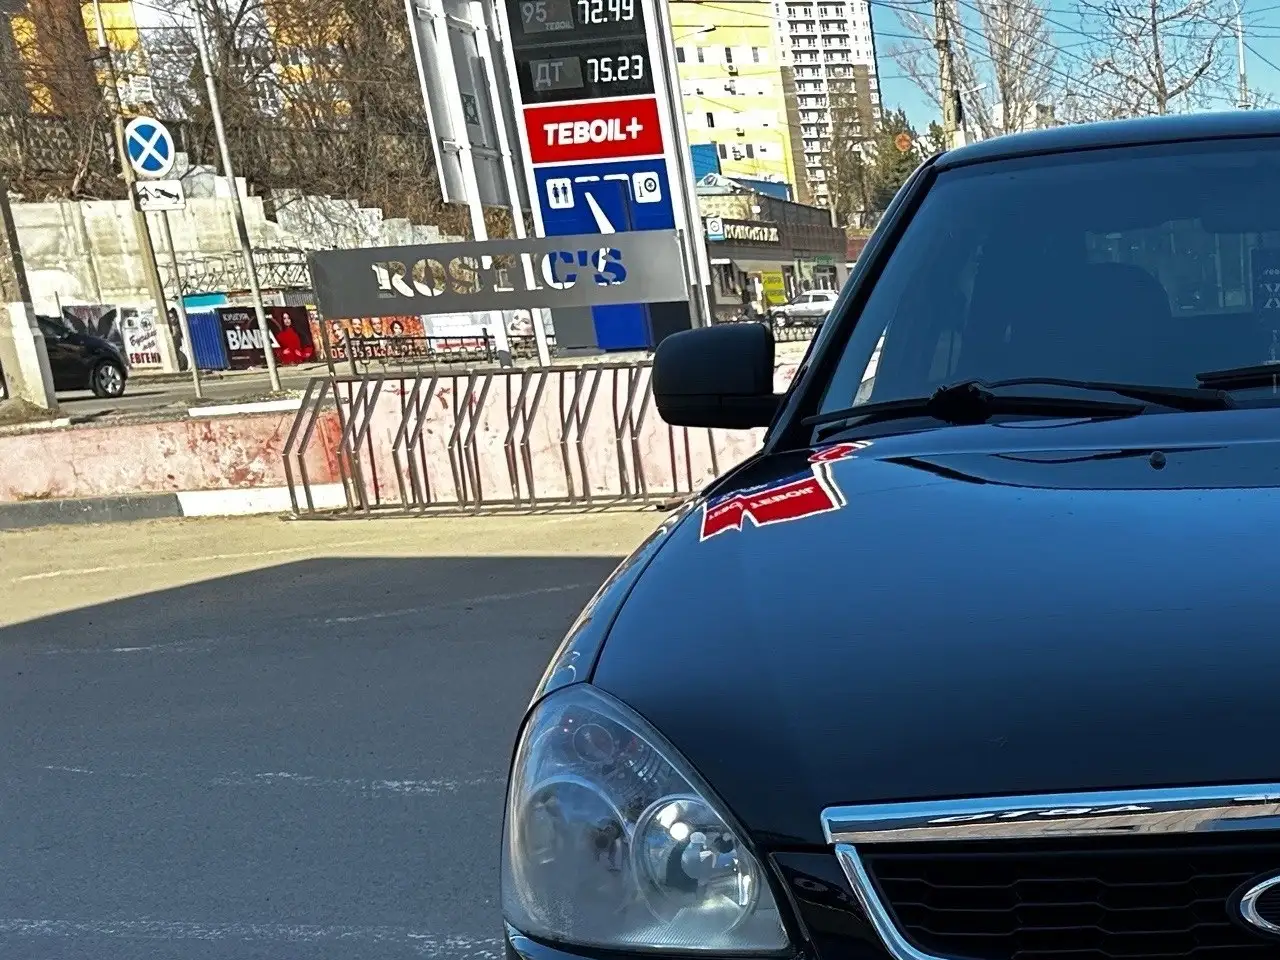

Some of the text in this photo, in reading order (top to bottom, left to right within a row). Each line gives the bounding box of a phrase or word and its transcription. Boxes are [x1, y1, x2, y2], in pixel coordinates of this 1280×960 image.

[521, 1, 547, 24] 95
[535, 61, 563, 88] ДТ
[587, 55, 644, 83] 75.23
[543, 117, 644, 146] TEBOIL+
[371, 247, 628, 298] ROSTIC'S
